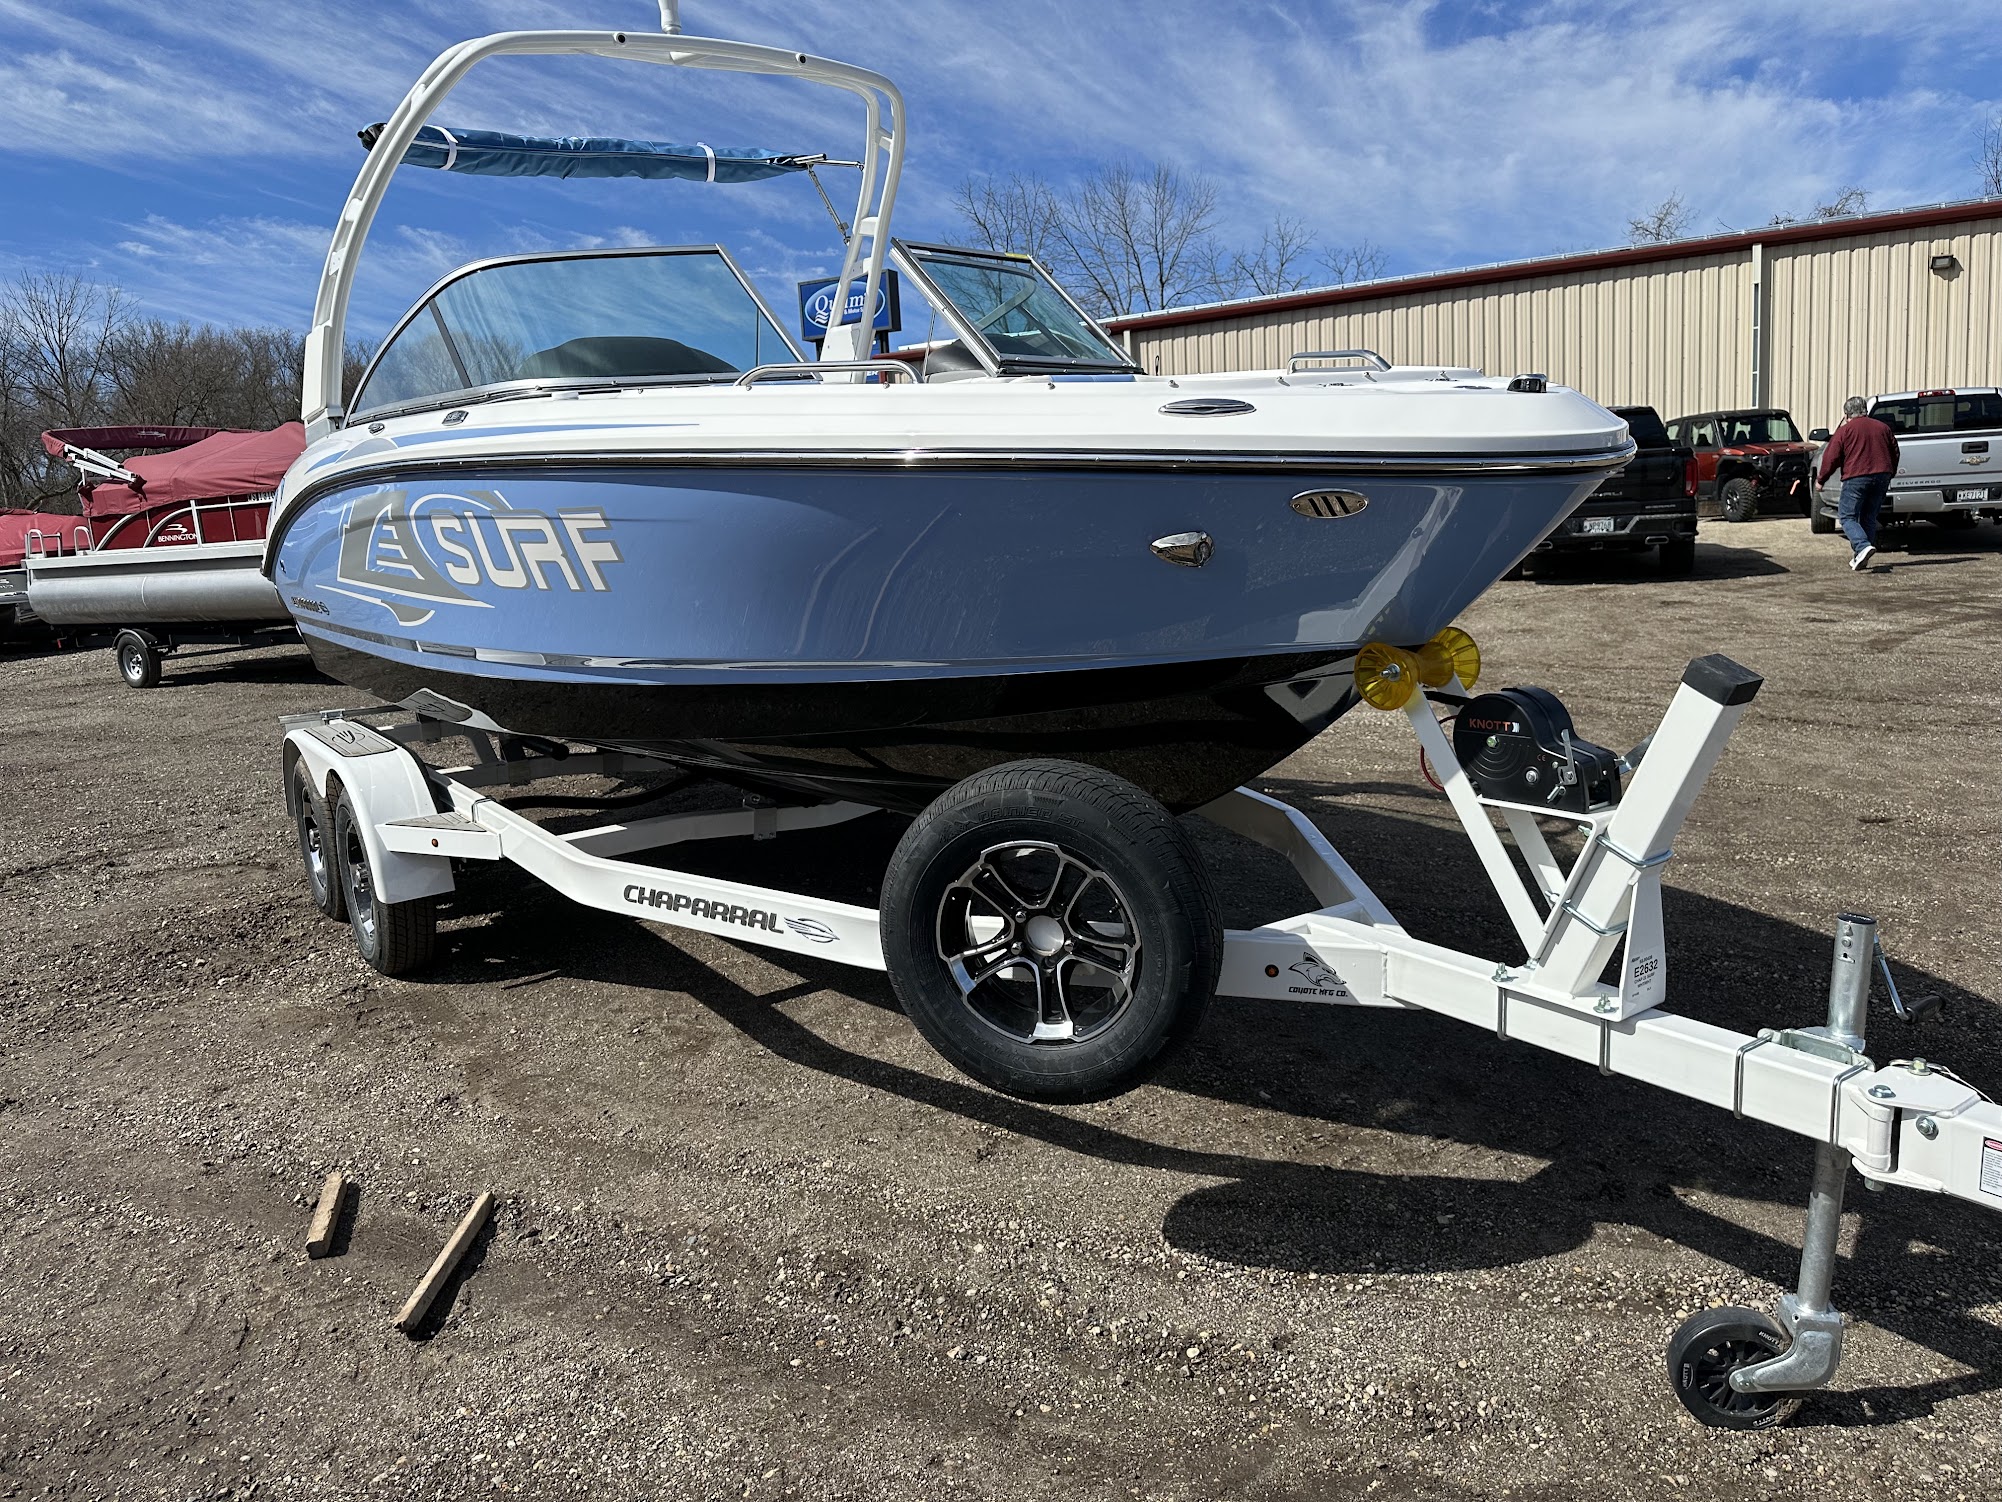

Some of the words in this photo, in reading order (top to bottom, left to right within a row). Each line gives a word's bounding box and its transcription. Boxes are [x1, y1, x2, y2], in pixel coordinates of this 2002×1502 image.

[429, 506, 624, 592] SURF
[1469, 718, 1510, 732] KNOTT
[623, 885, 785, 934] CHAPARRAL
[1634, 959, 1658, 978] E2632
[1288, 986, 1317, 995] COYOTE
